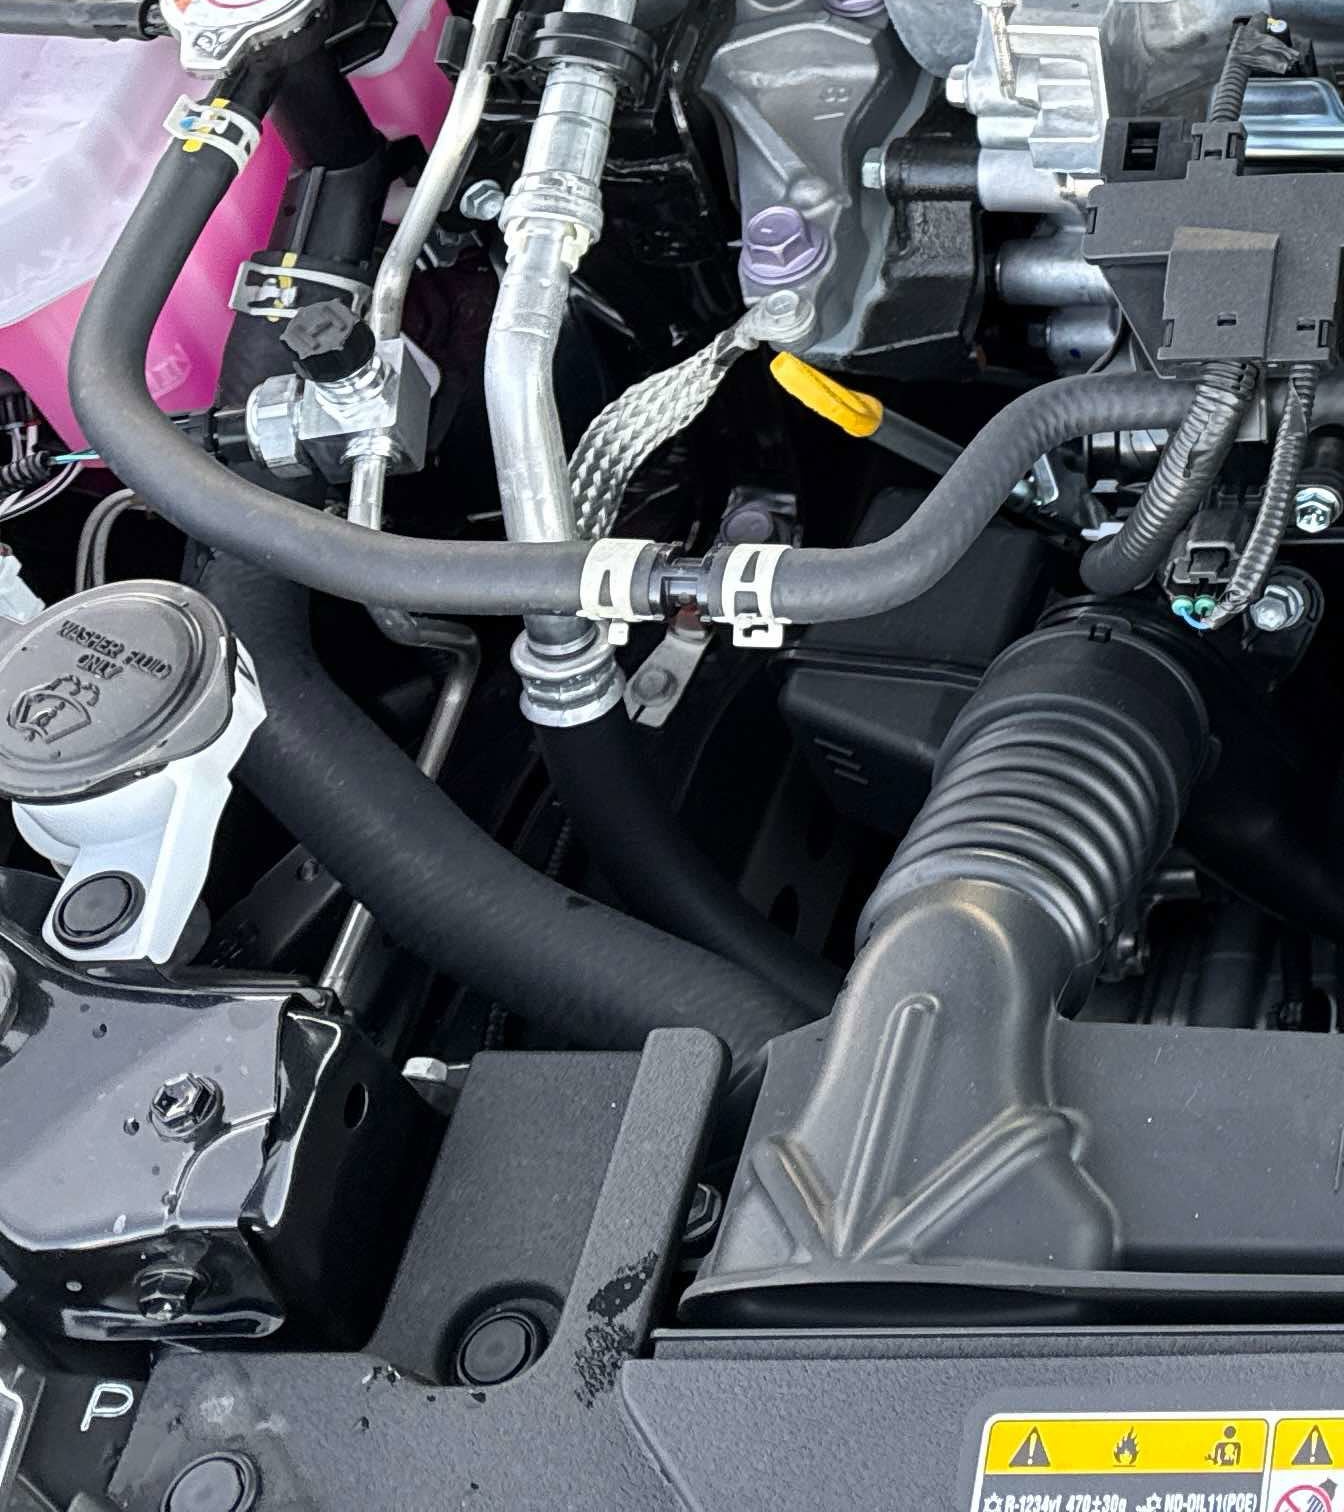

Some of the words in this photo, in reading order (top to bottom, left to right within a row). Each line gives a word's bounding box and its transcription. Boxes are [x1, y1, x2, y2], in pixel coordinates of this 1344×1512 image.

[57, 620, 125, 659] WASHER
[122, 650, 173, 680] FLUID
[76, 653, 125, 680] ONLY
[80, 1382, 134, 1432] P
